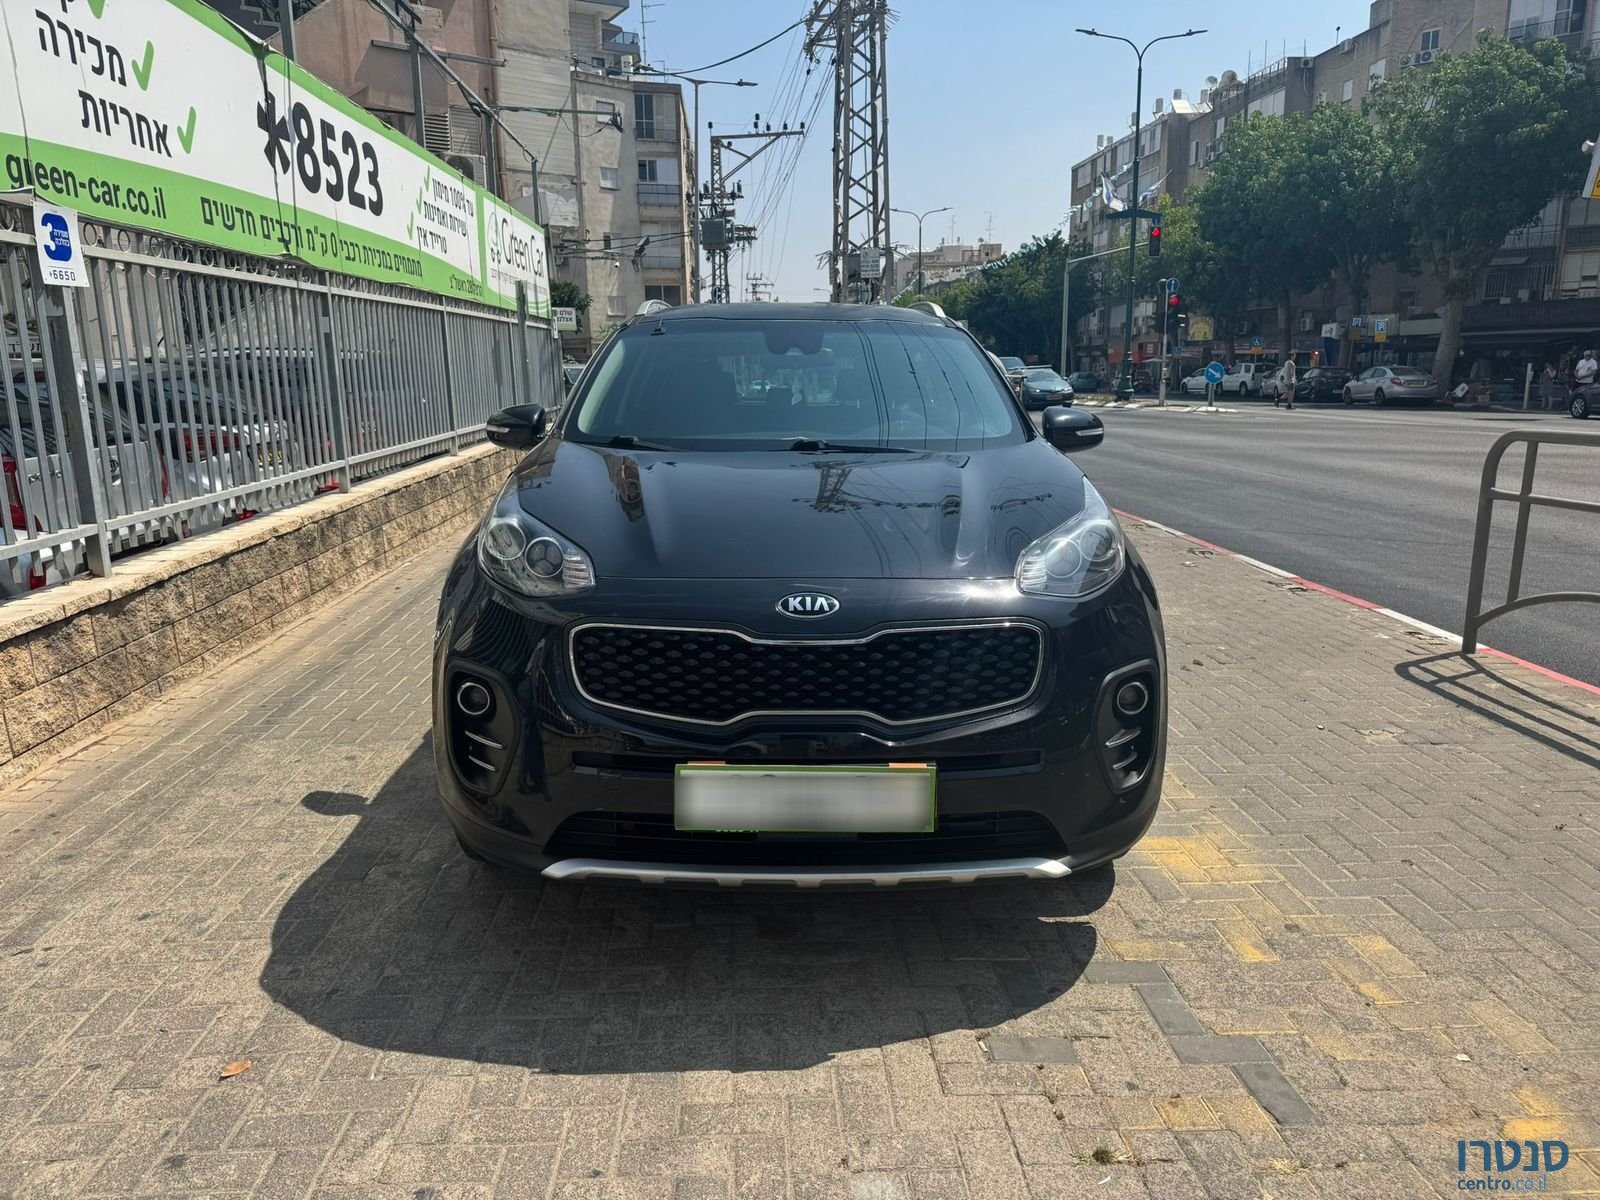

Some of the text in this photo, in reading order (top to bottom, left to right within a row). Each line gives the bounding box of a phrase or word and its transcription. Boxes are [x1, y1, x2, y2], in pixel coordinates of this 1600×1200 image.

[35, 9, 127, 87] מכירה
[78, 89, 172, 158] אחריות
[6, 153, 167, 219] green-car.co.il
[200, 196, 257, 237] חדשים
[501, 217, 531, 272] Green
[788, 596, 830, 612] KIA
